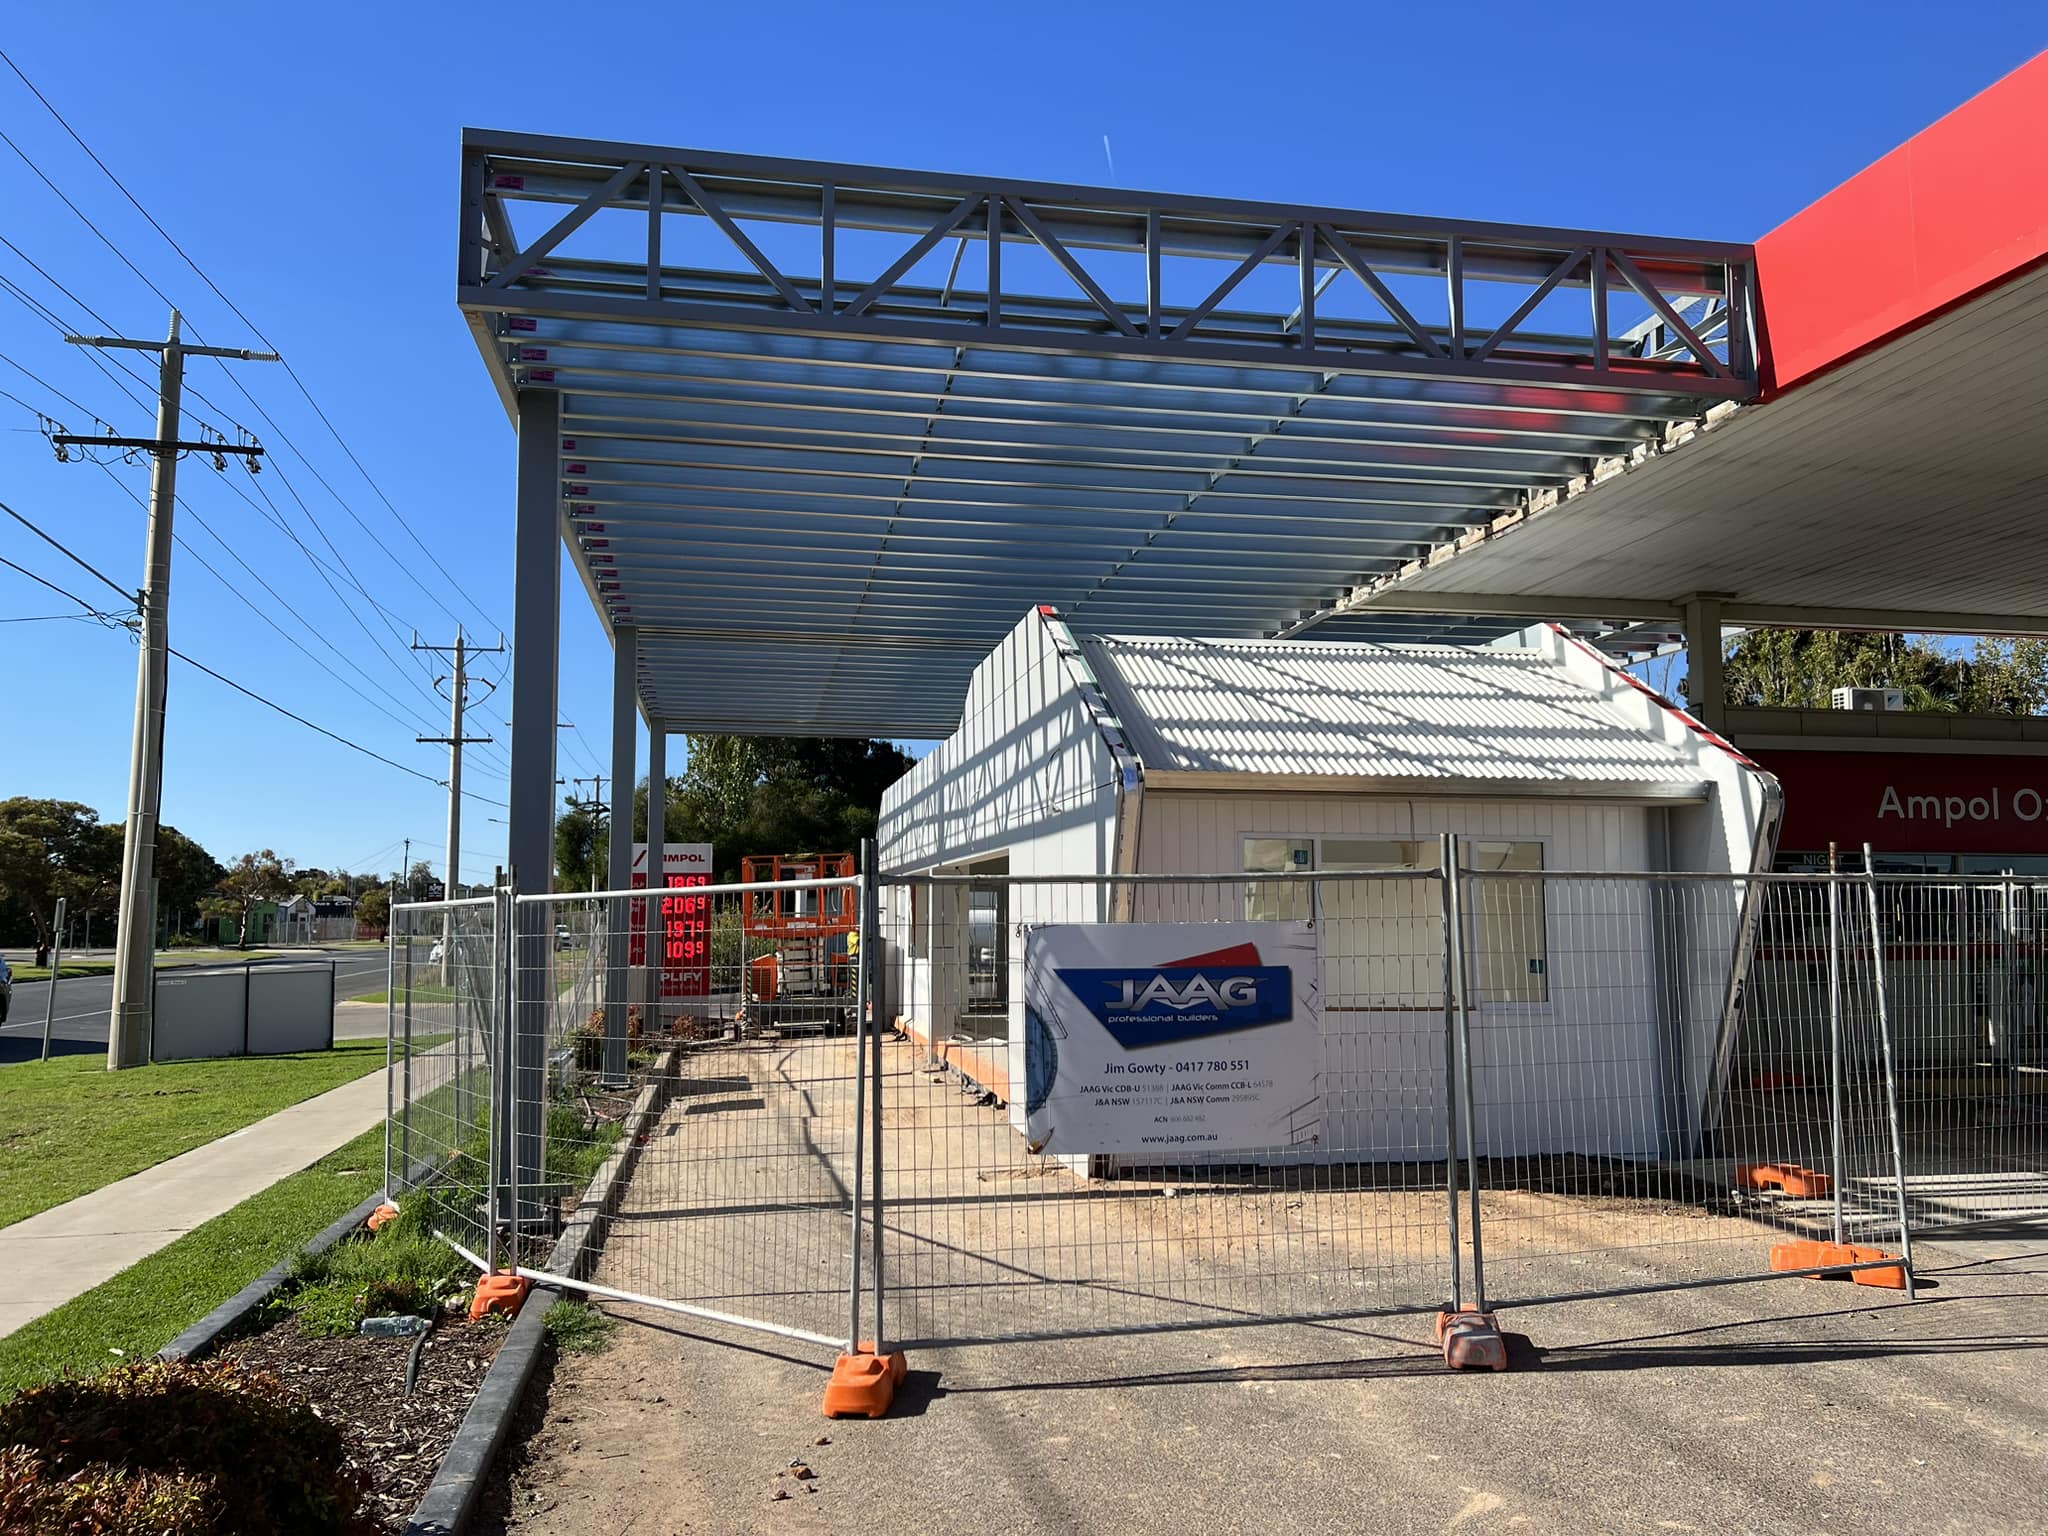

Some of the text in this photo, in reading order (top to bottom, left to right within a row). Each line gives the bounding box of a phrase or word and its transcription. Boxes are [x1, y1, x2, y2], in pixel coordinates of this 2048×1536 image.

[1877, 786, 2048, 828] Ampol O
[1803, 855, 1844, 865] NIGT
[667, 921, 705, 938] 1979
[666, 941, 704, 958] 1099
[1105, 973, 1257, 1012] JAAG
[1108, 1014, 1219, 1023] professional builders
[1104, 1063, 1125, 1074] Jim
[1128, 1063, 1166, 1076] Gowty
[1175, 1062, 1204, 1073] 0417
[1207, 1061, 1228, 1072] 780
[1230, 1060, 1249, 1071] 551
[1080, 1085, 1101, 1094] JAAG
[1171, 1083, 1192, 1092] JAAG
[1205, 1082, 1230, 1091] Comm
[1111, 1097, 1130, 1106] NSW
[1186, 1095, 1205, 1104] NSW
[1205, 1095, 1230, 1103] Comm
[1154, 1115, 1168, 1123] ACN
[1141, 1133, 1218, 1144] www.jaag.com.au
